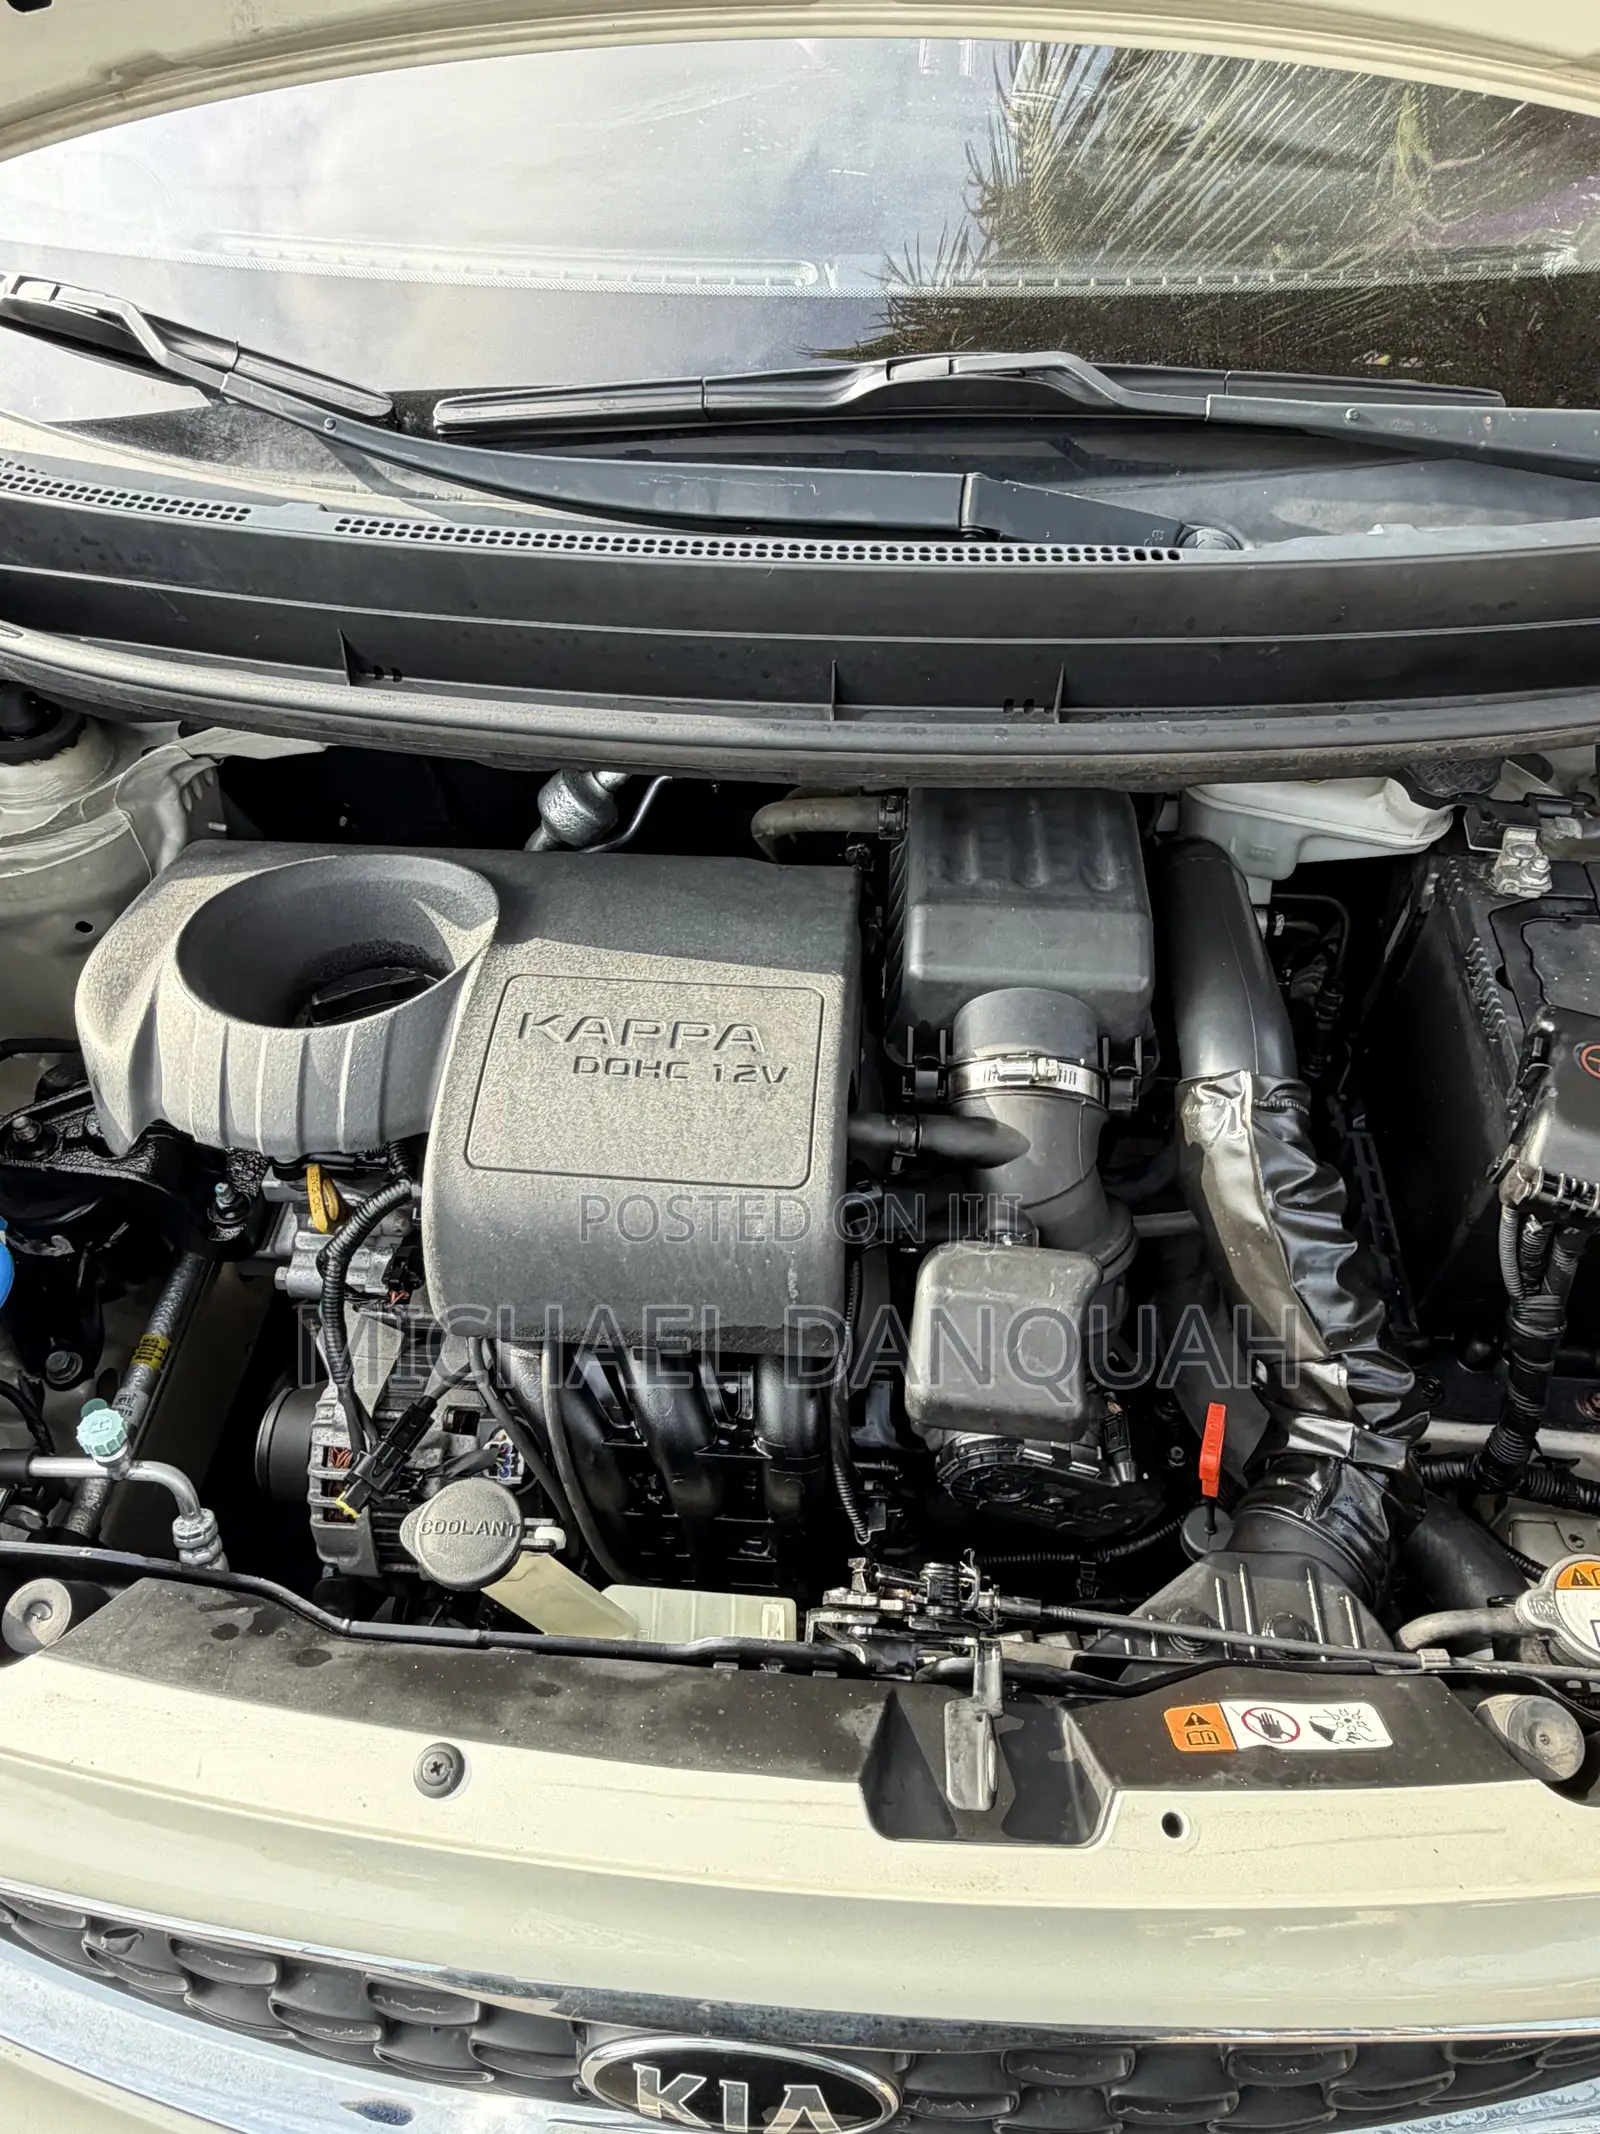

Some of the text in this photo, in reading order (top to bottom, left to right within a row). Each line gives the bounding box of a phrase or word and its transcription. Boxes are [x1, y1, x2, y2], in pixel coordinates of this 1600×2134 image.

[517, 1012, 766, 1053] KAPPA
[572, 1055, 789, 1084] DOHC 12V
[420, 1519, 522, 1538] COOLANT
[632, 2062, 843, 2134] KIA
